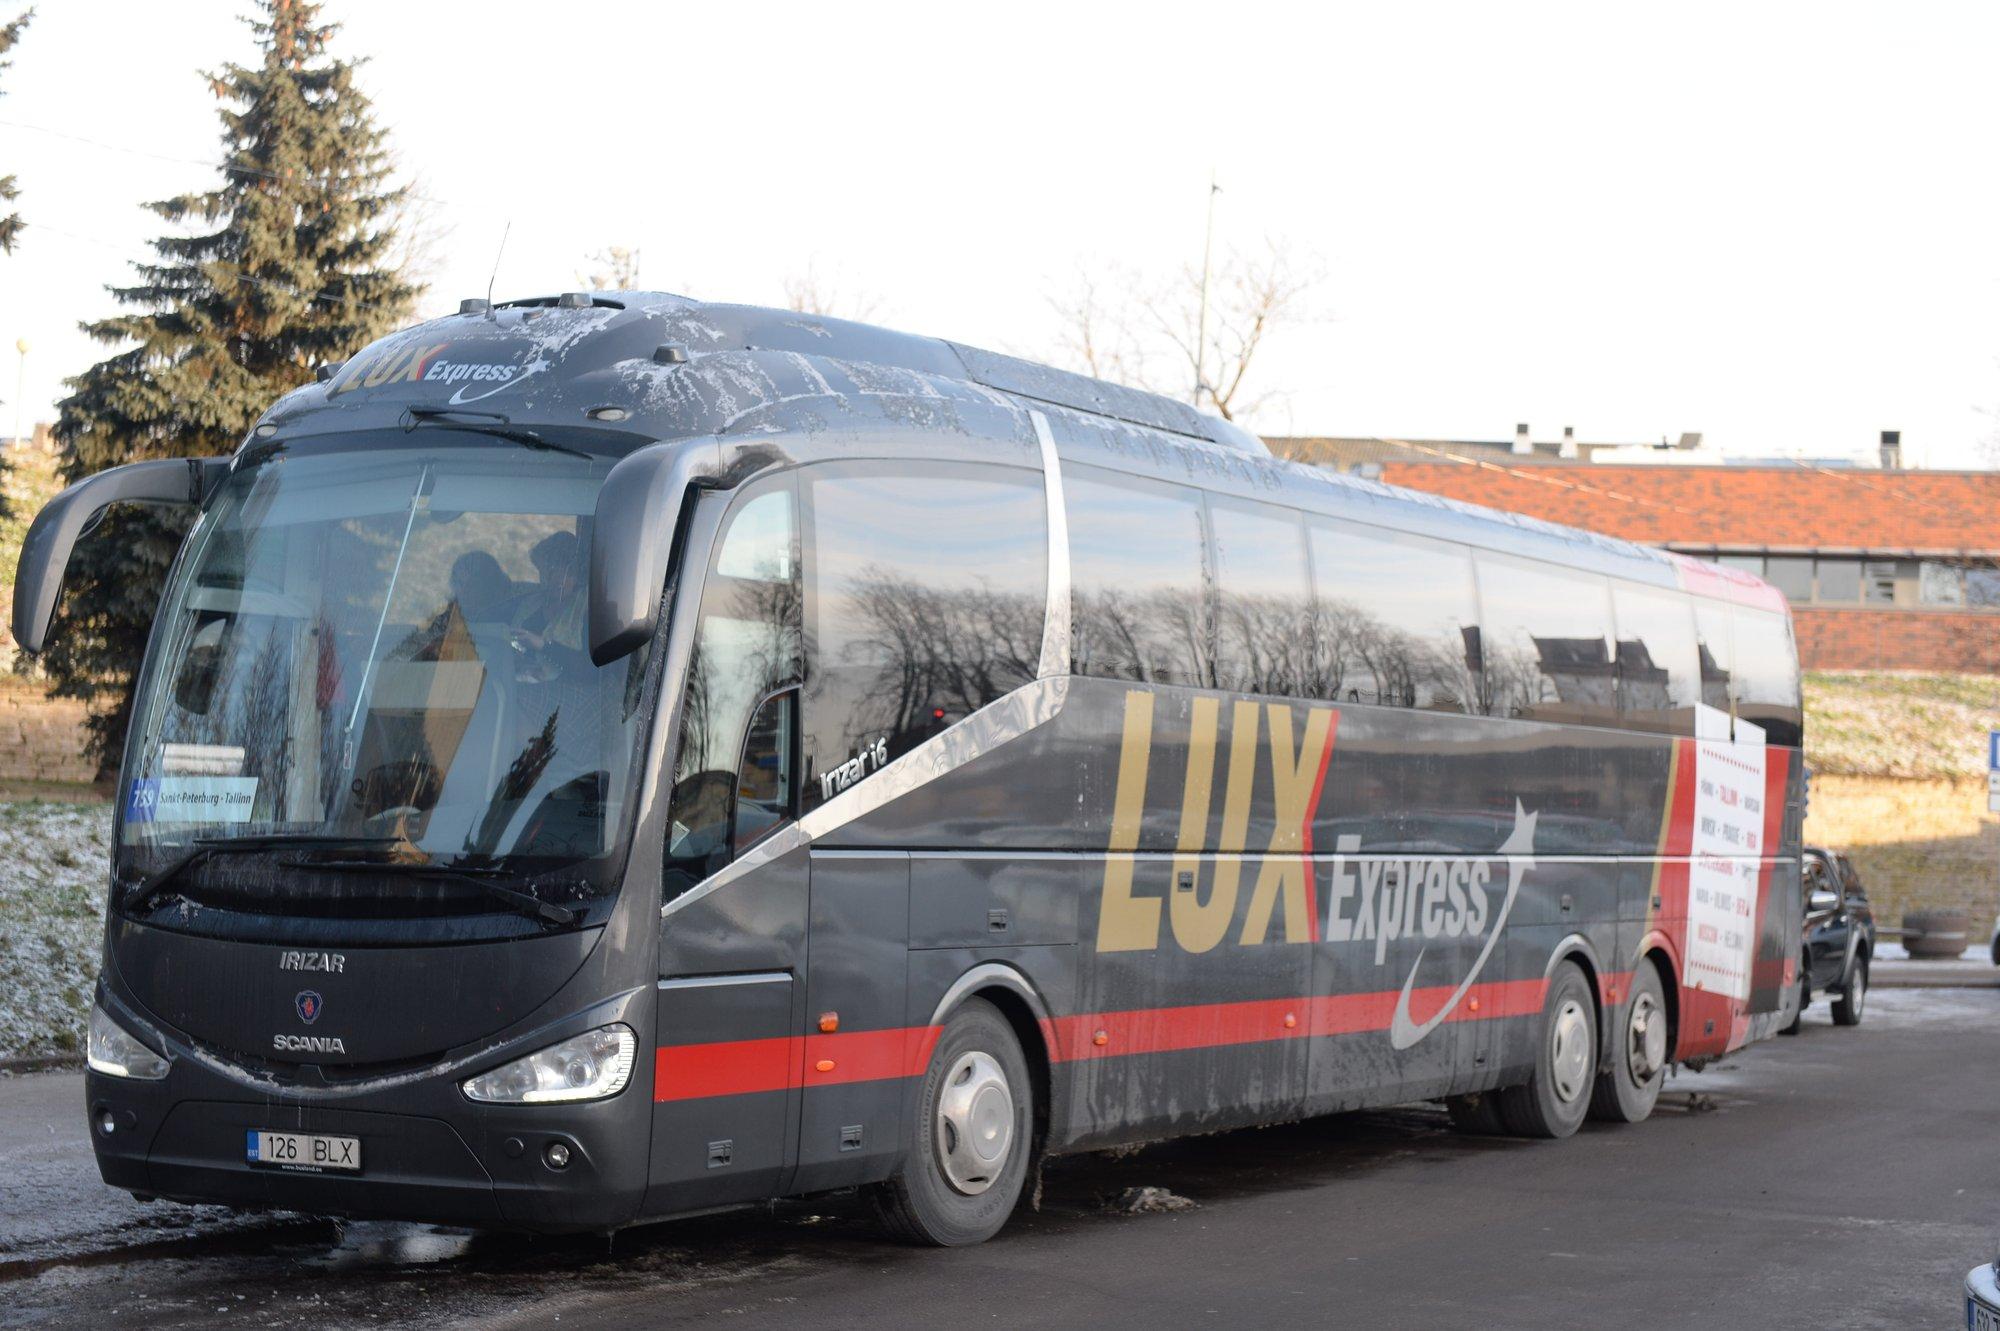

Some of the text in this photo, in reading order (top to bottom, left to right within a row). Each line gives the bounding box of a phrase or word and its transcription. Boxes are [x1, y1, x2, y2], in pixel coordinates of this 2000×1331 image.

[337, 344, 517, 394] LUX Express
[870, 737, 888, 770] i6
[225, 793, 251, 804] Tallinn
[1096, 690, 1491, 965] LUX Express
[279, 951, 346, 973] IRIZAR
[273, 1034, 345, 1054] SCANIA
[247, 1149, 258, 1157] EST
[268, 1136, 353, 1164] 126 BLX
